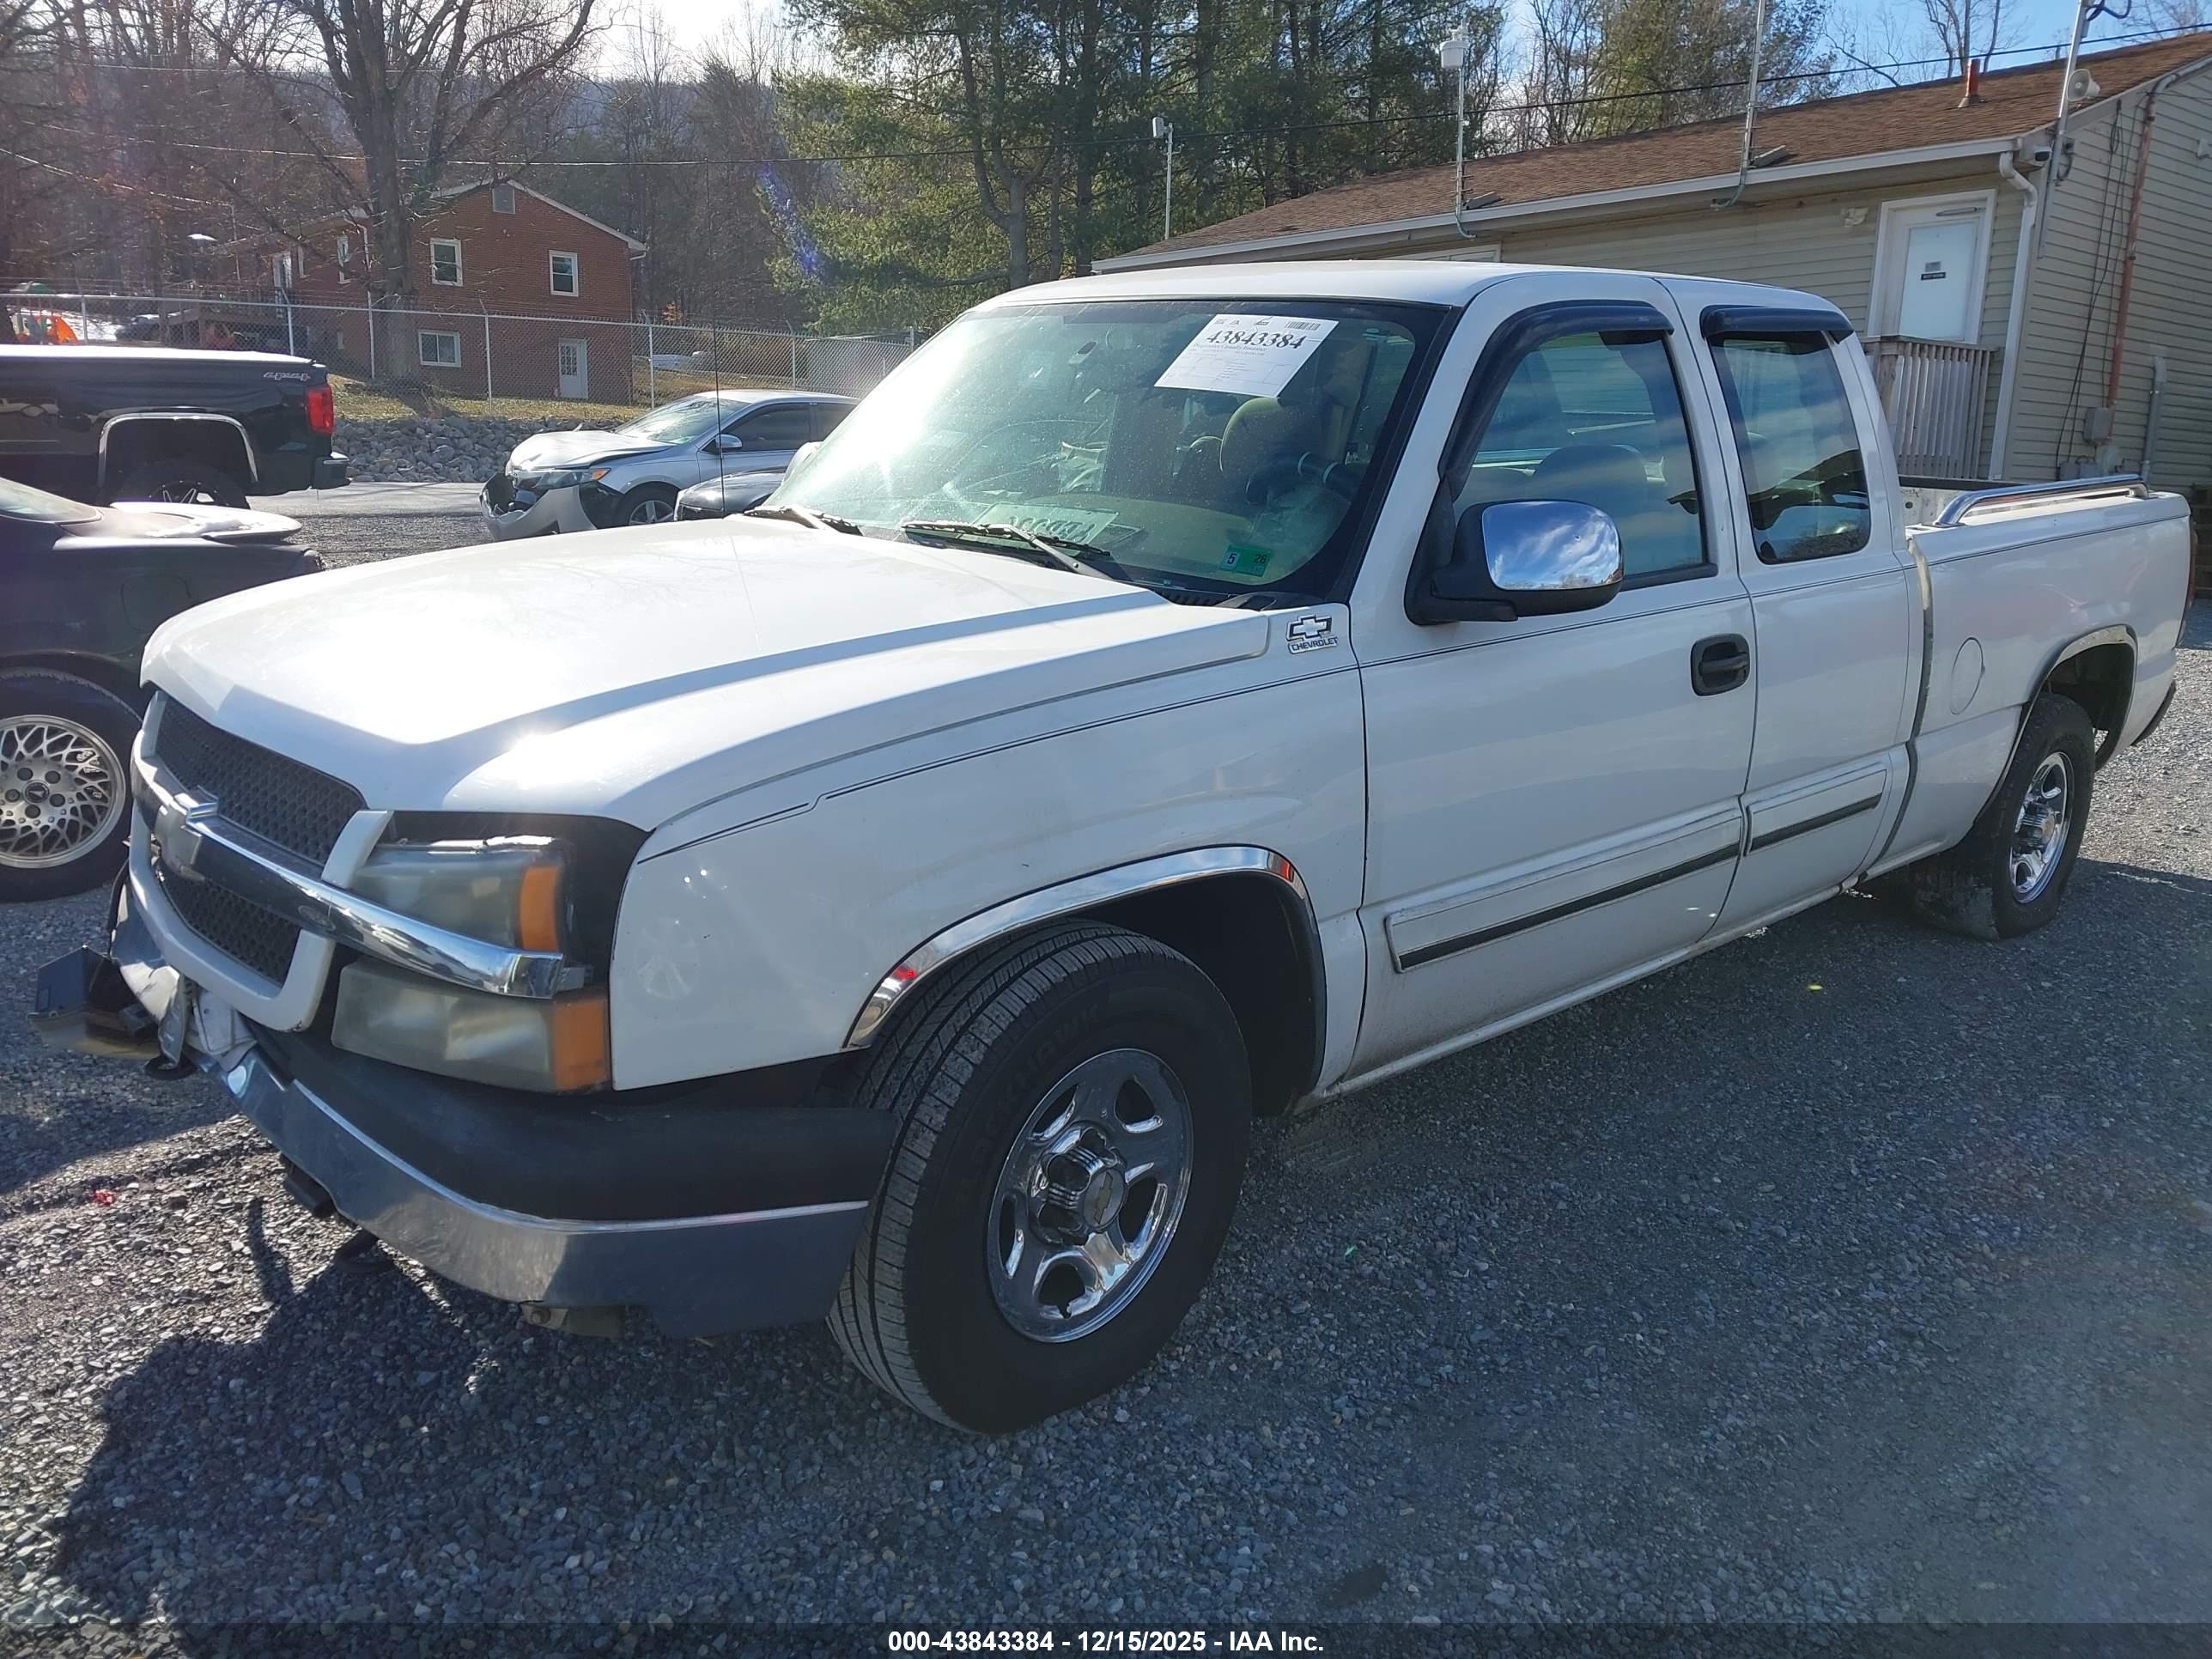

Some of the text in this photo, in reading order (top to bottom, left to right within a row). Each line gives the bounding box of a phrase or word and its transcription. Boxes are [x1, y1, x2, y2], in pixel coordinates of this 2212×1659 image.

[1206, 330, 1308, 349] 43843384
[1227, 552, 1237, 564] 5
[1291, 636, 1338, 651] CHEVROLET
